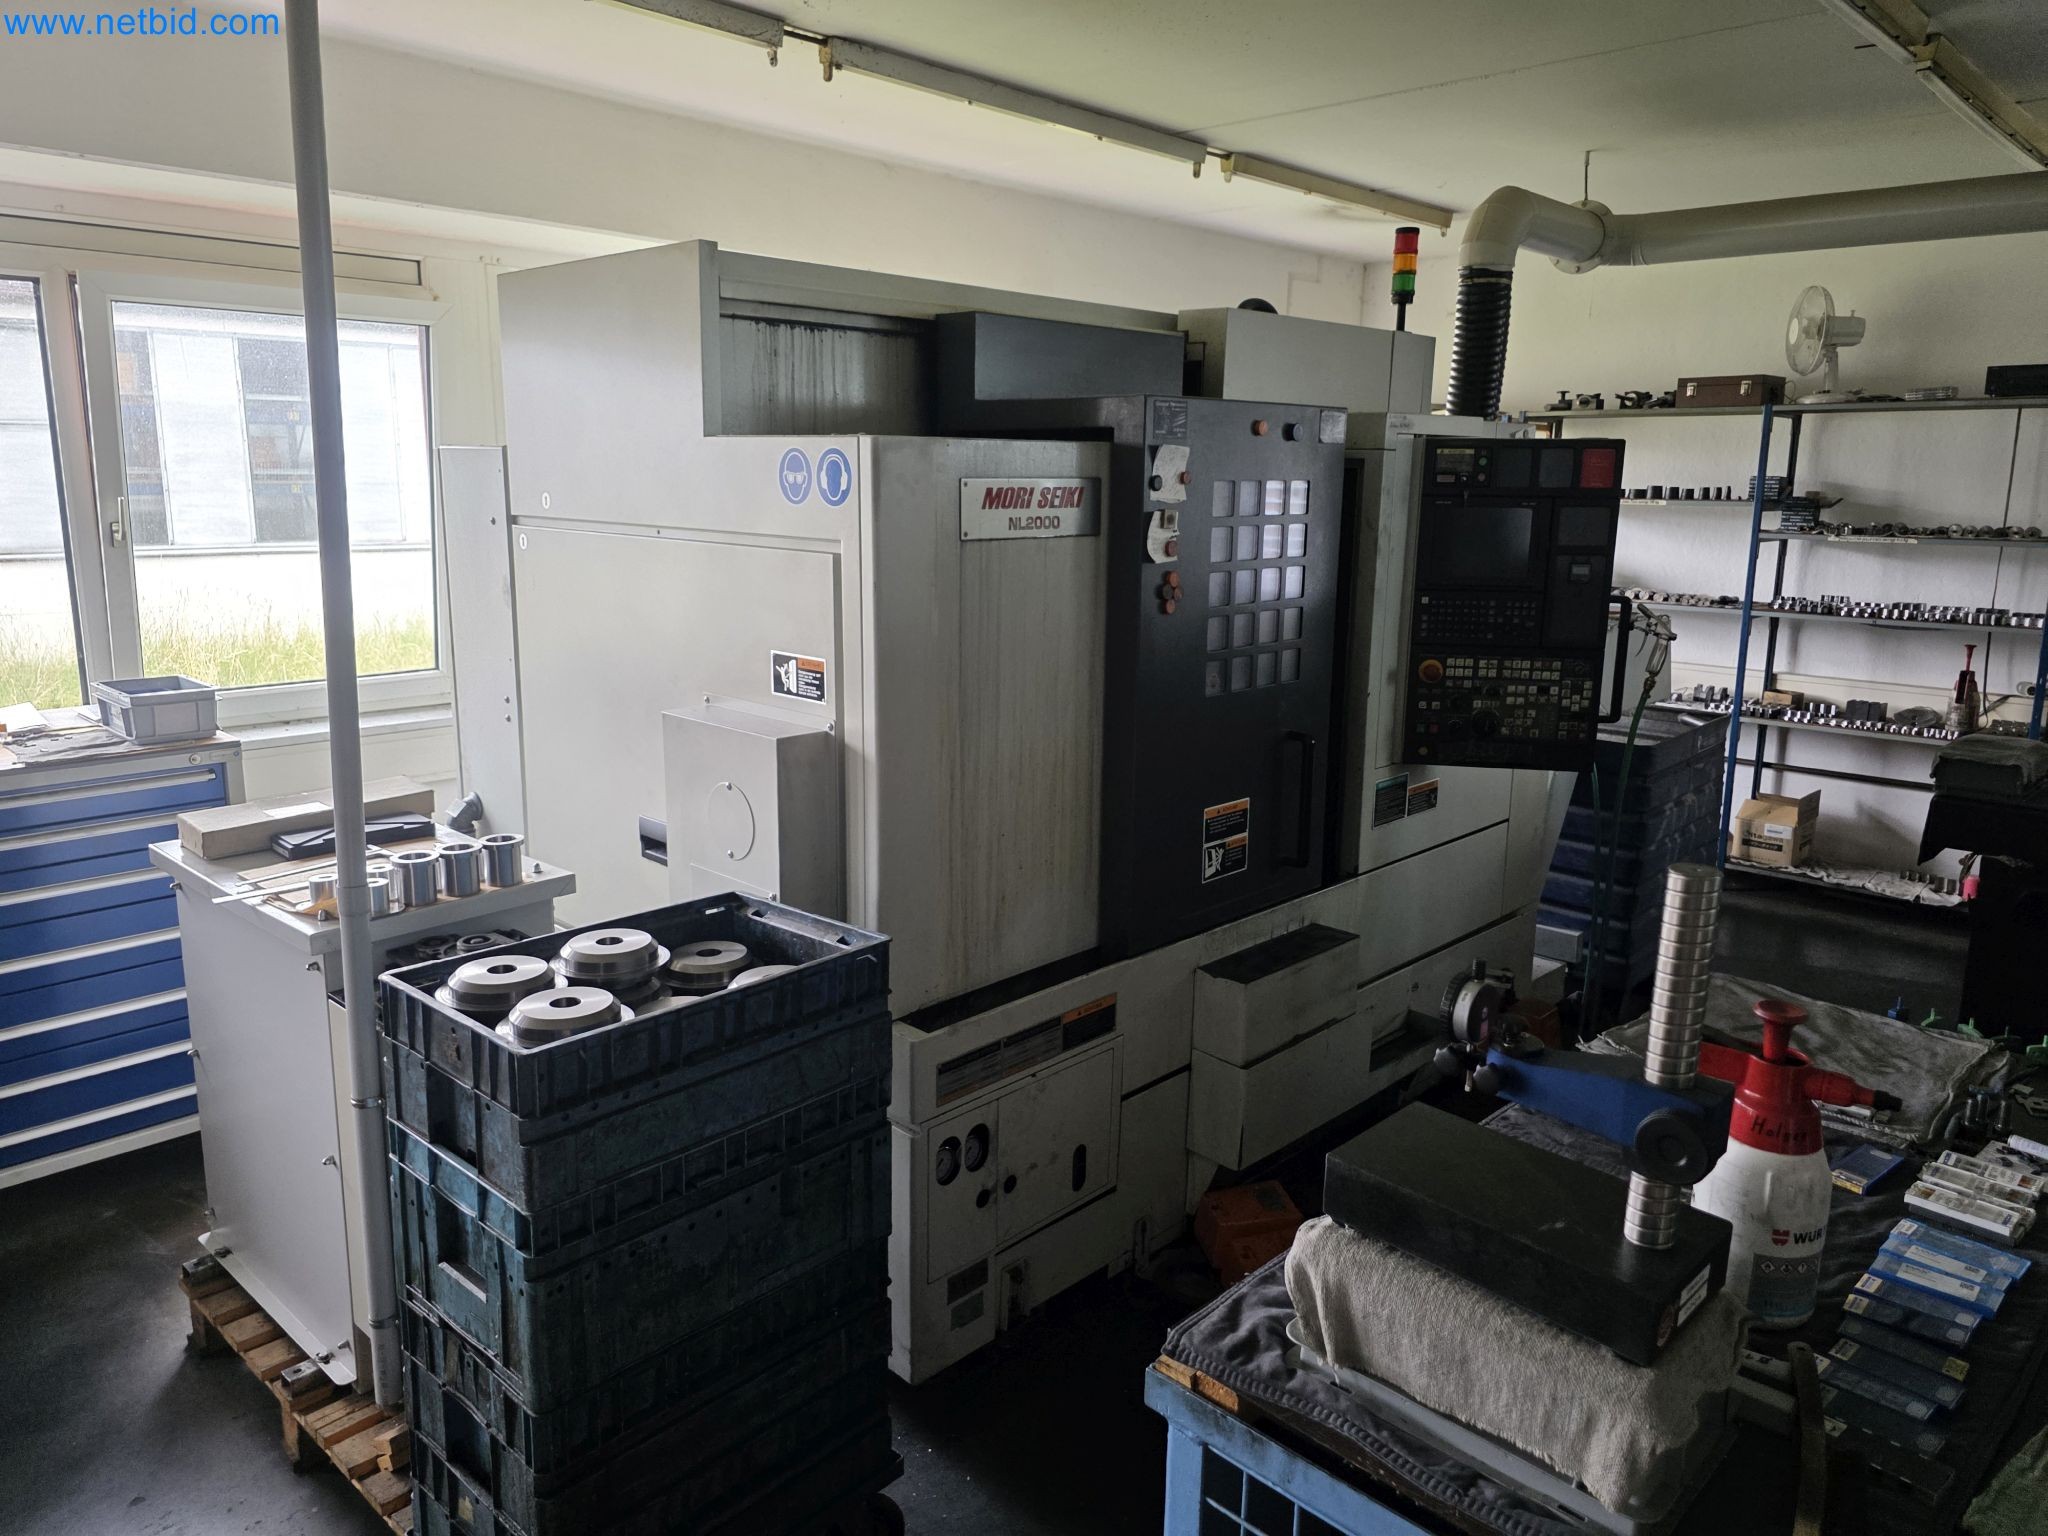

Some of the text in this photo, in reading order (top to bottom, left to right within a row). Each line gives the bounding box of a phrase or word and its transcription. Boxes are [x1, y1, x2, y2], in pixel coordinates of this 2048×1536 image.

[981, 486, 1085, 510] MORI SEIKI
[1008, 515, 1060, 531] NL2000
